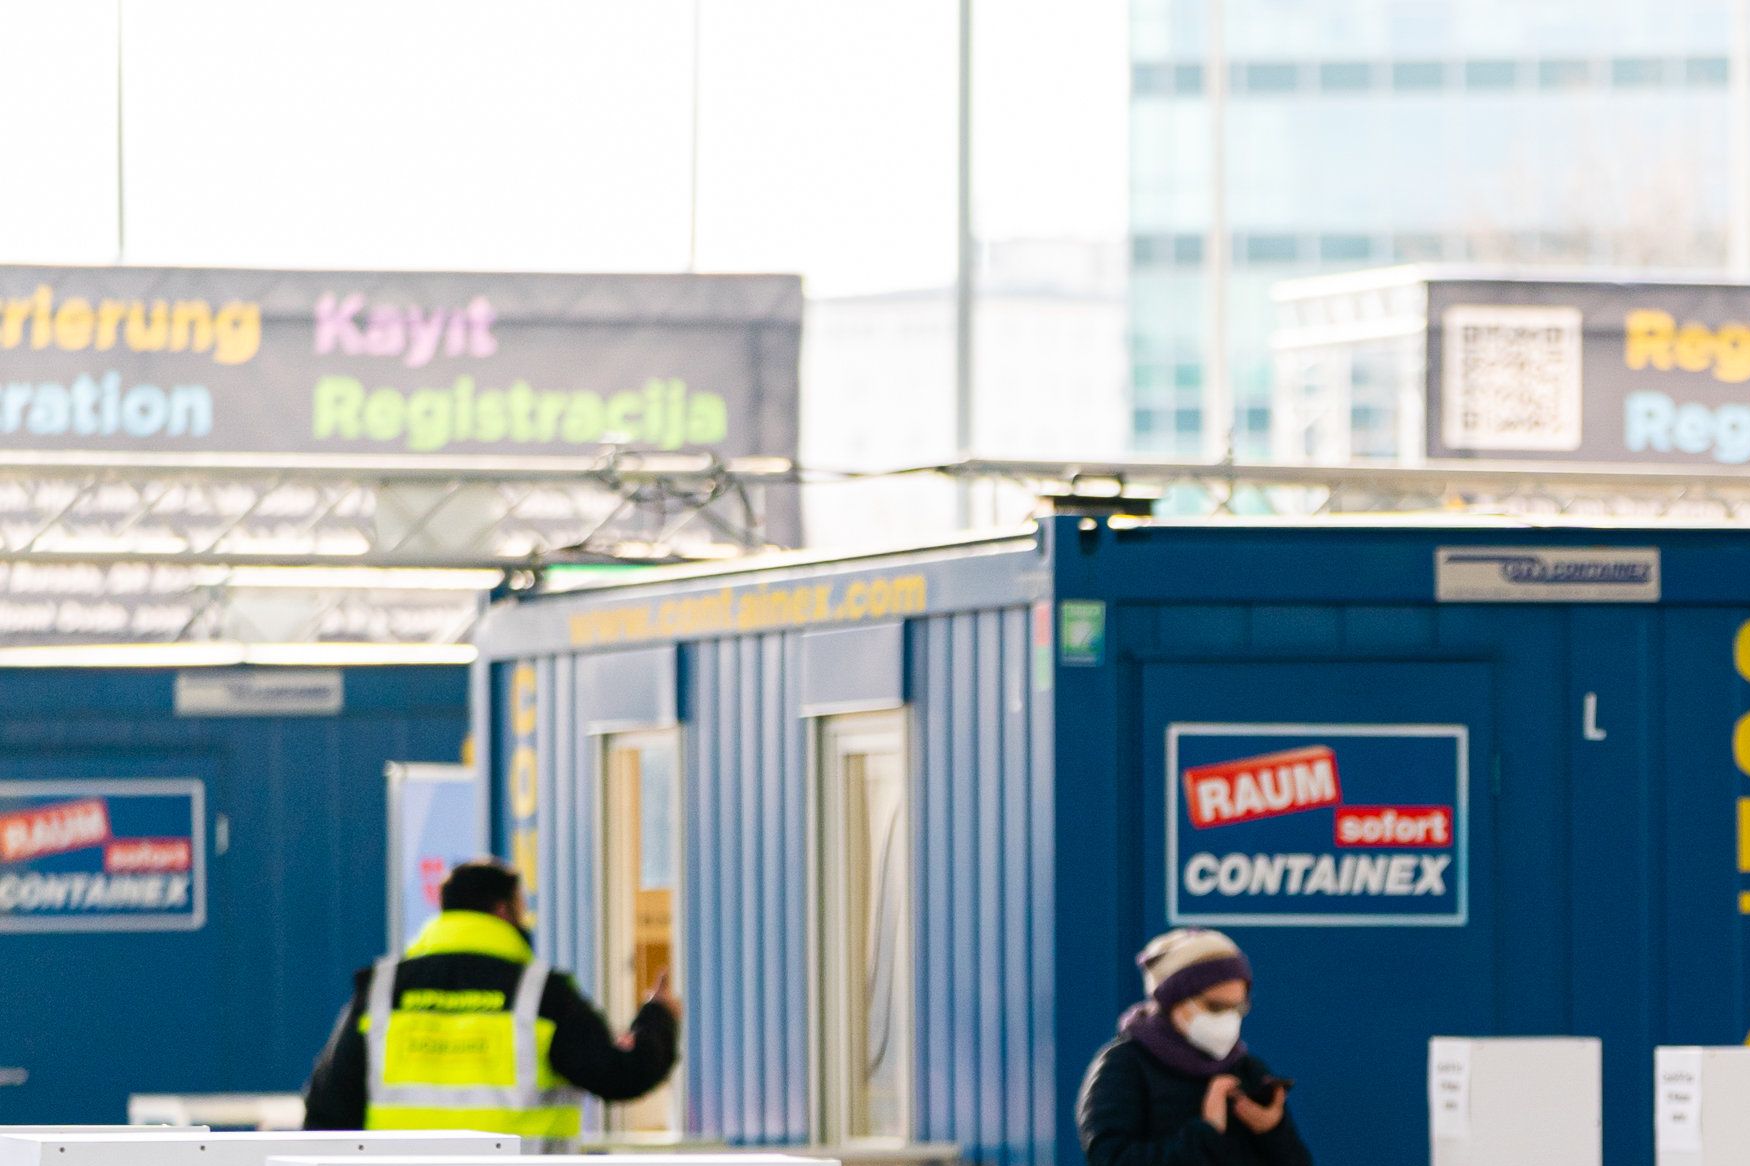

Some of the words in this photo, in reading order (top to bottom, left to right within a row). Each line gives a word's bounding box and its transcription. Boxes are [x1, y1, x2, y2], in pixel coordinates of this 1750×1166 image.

[312, 374, 728, 451] Registracija
[510, 664, 537, 928] CON
[1197, 758, 1337, 823] RAUM
[1340, 809, 1448, 844] sofort
[1184, 851, 1450, 896] CONTAINEX
